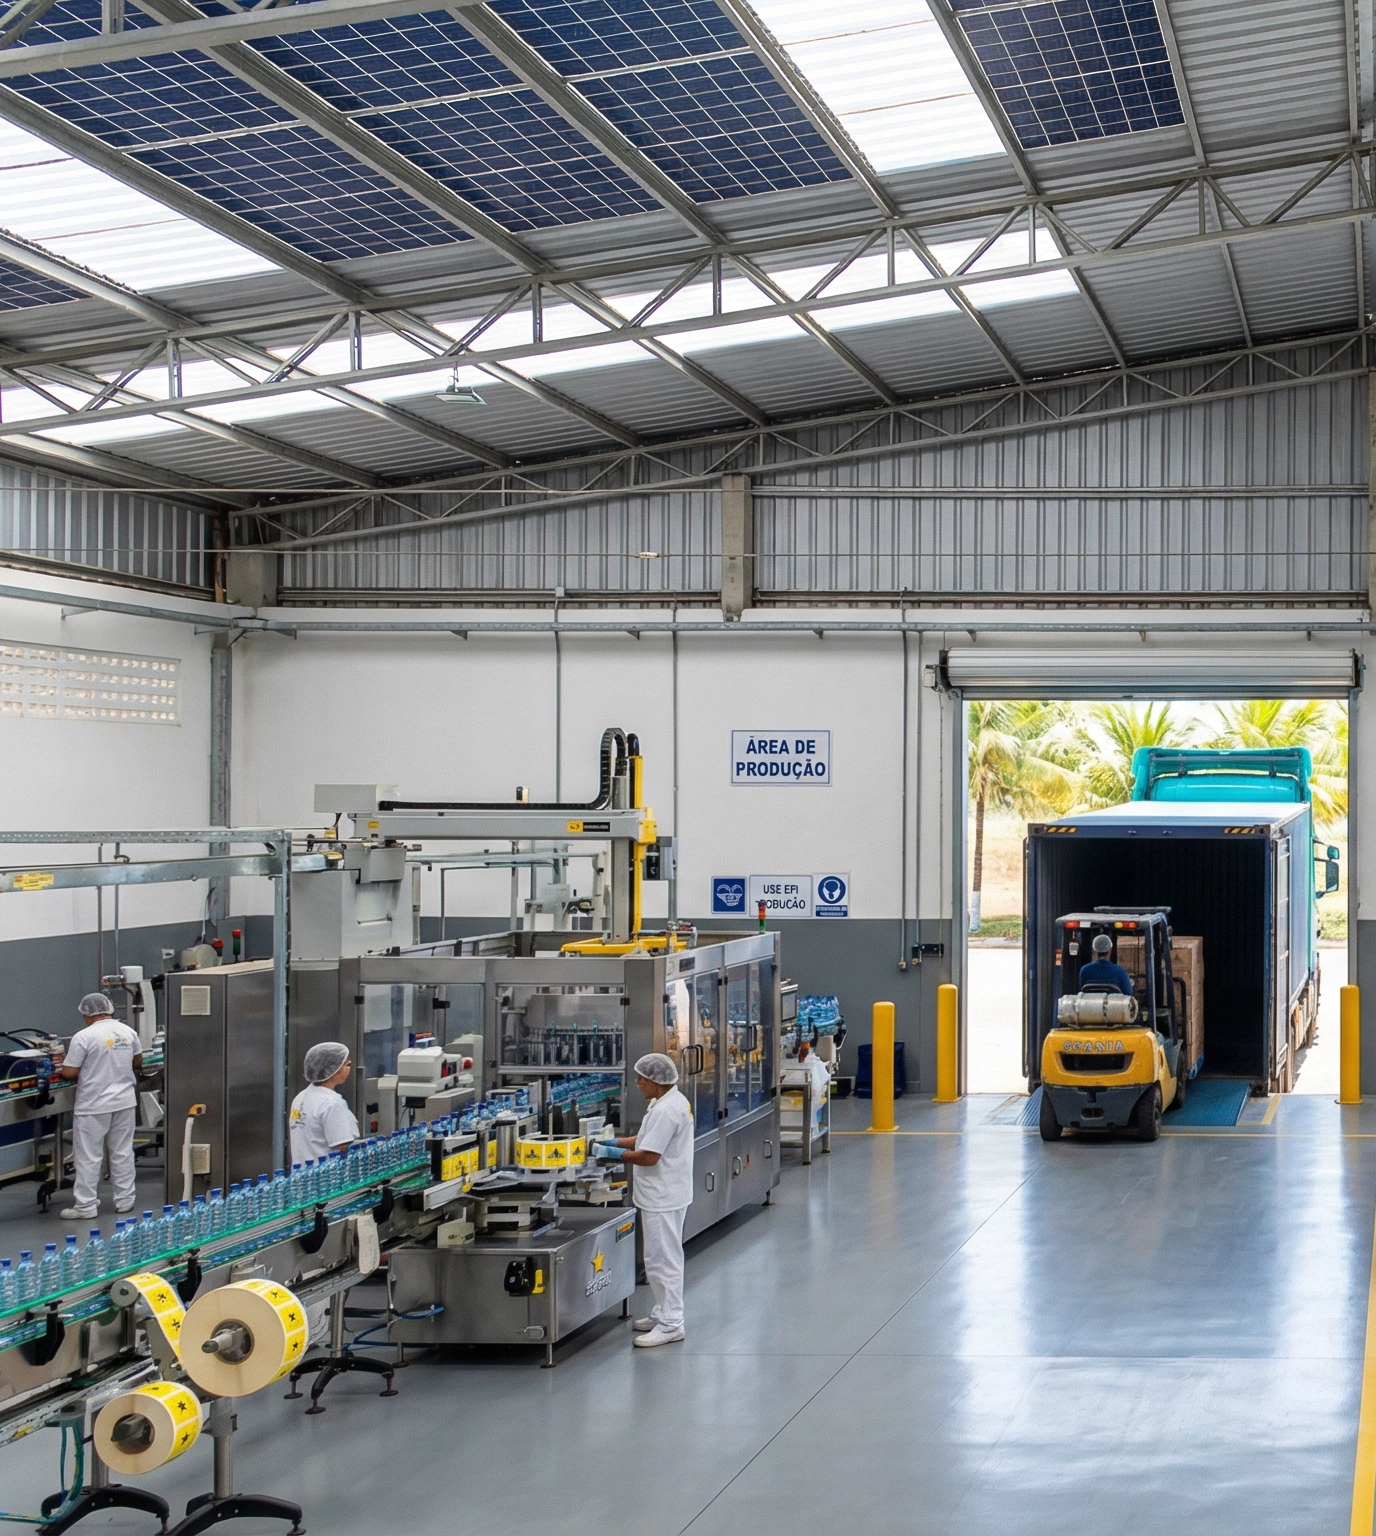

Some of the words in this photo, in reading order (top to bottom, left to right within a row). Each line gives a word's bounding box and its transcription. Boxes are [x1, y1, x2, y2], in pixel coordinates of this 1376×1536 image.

[795, 740, 816, 754] DE
[736, 759, 826, 780] PRODUÇÃO
[763, 884, 782, 894] USE
[784, 884, 799, 894] EPI
